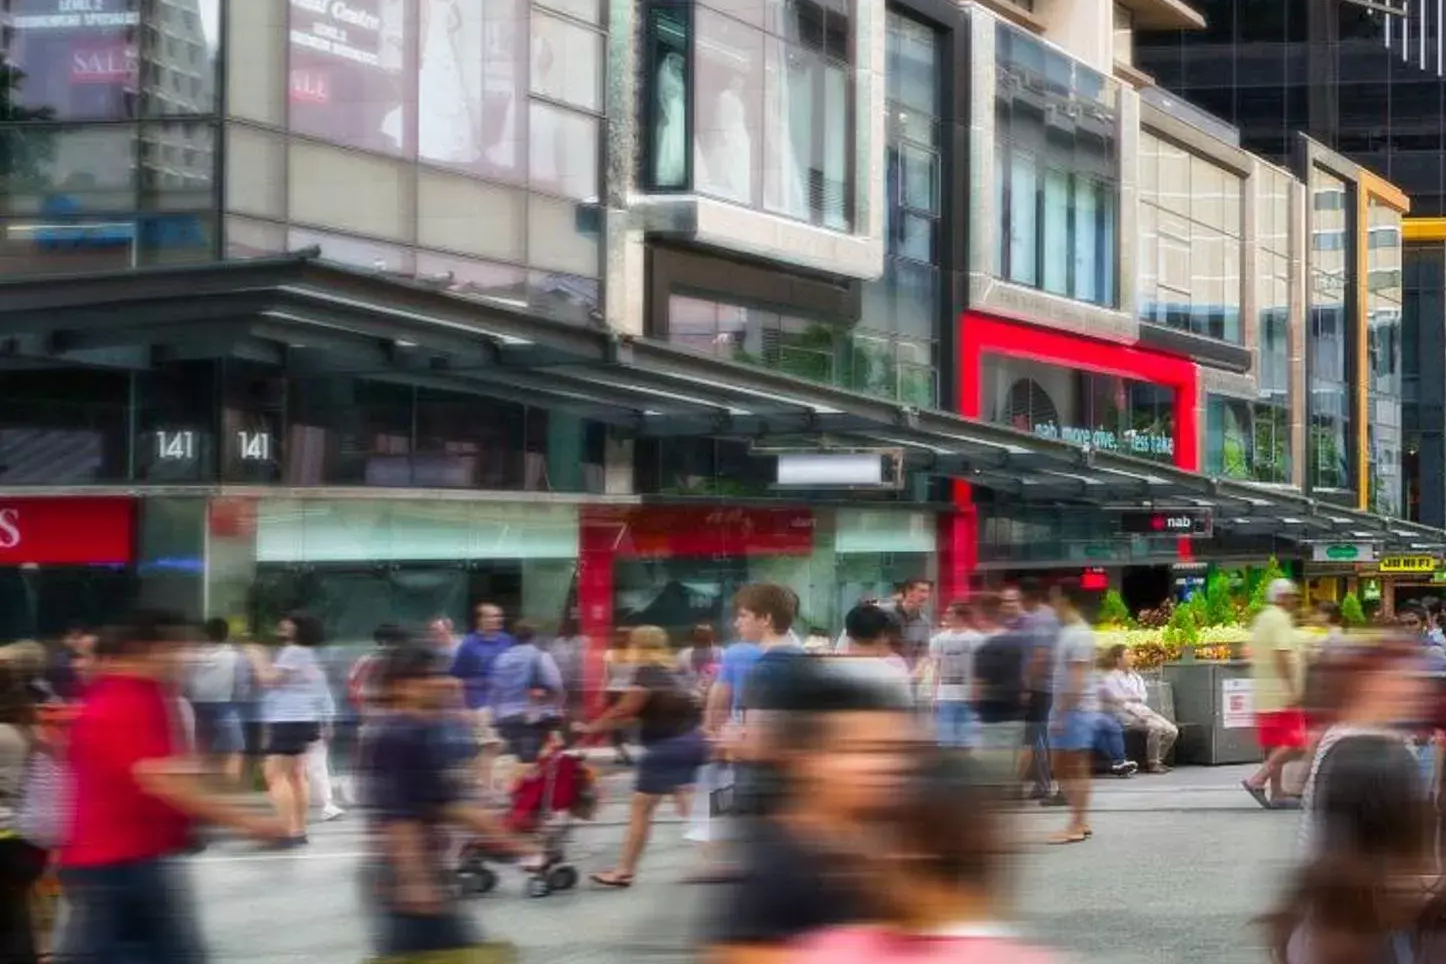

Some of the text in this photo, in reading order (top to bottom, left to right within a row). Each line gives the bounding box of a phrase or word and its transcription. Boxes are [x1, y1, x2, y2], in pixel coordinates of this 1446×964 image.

[156, 431, 269, 460] 141 141
[1167, 516, 1191, 528] nab
